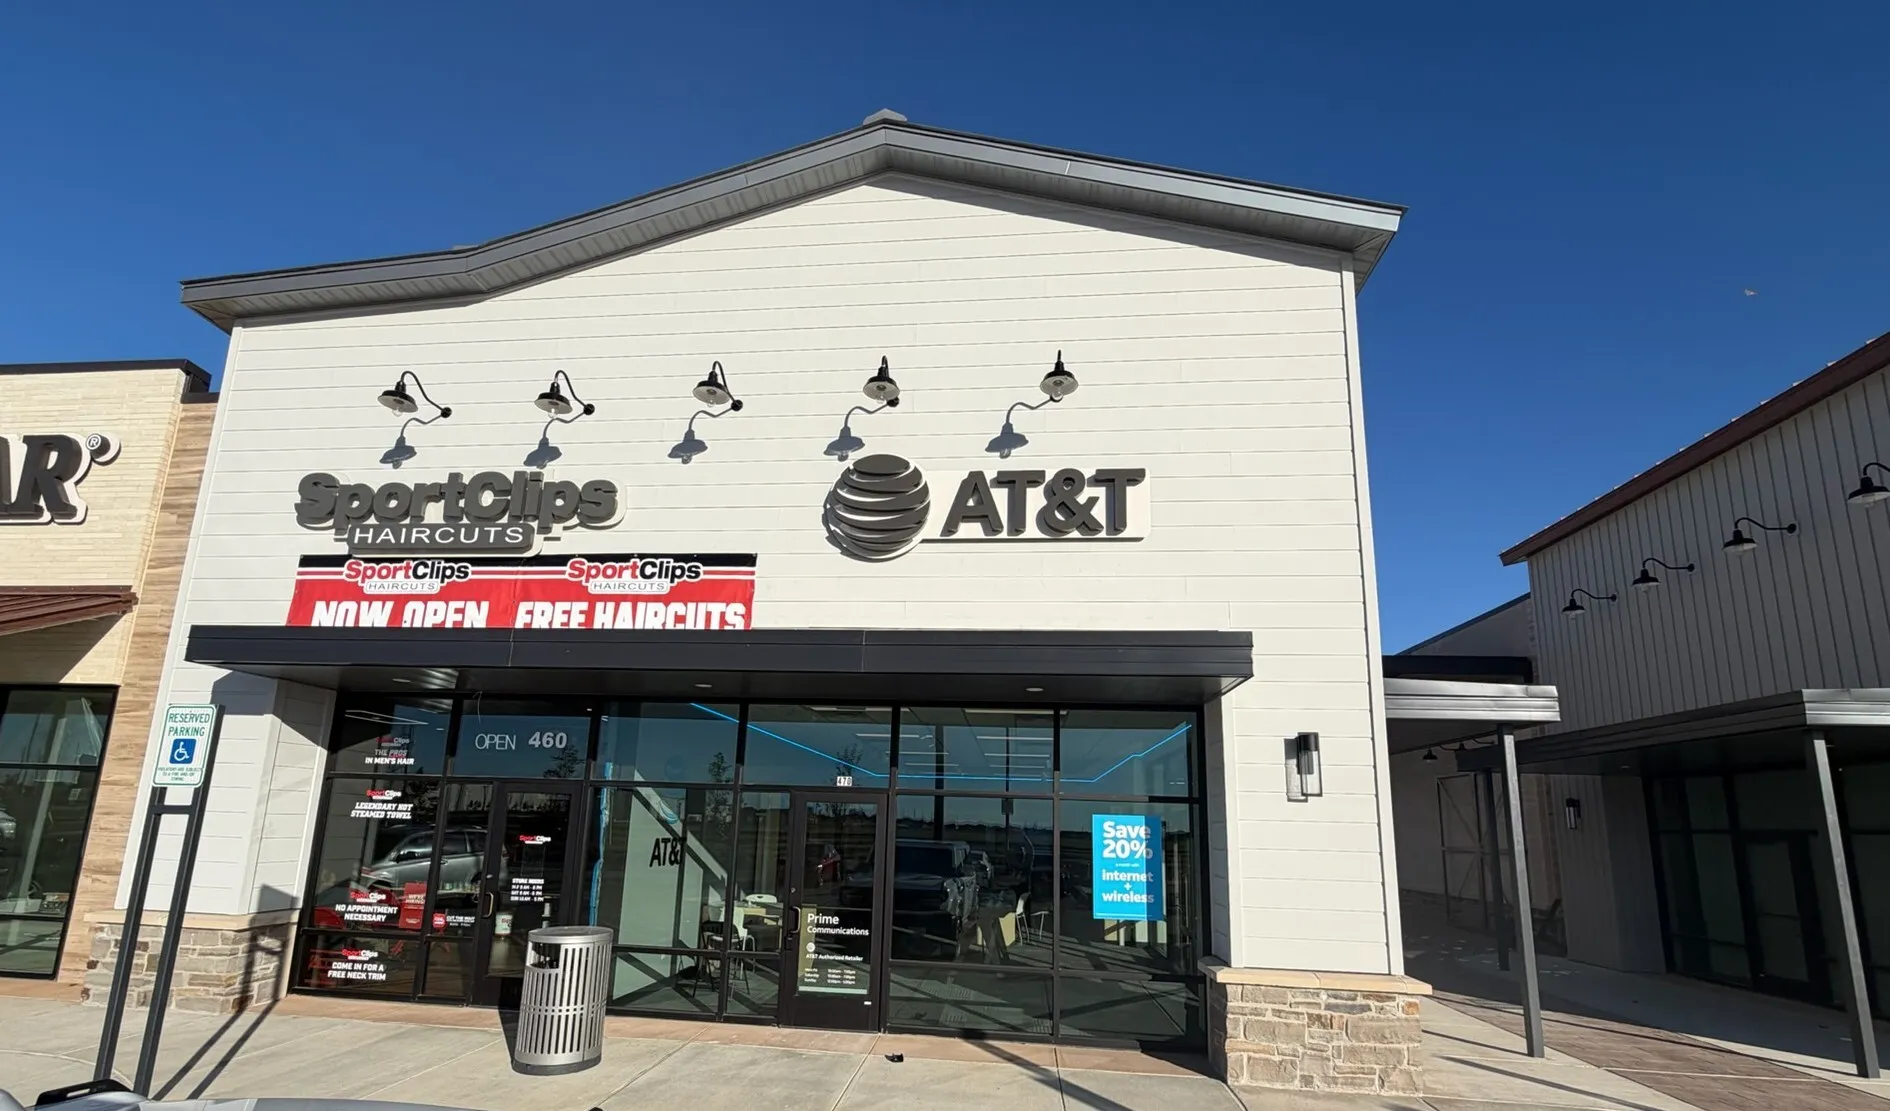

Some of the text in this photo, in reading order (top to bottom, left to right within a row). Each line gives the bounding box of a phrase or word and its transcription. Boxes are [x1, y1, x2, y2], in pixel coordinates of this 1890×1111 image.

[294, 470, 620, 534] SportClips
[940, 467, 1146, 537] AT&T
[353, 526, 524, 544] HAIRCUTS
[345, 560, 470, 583] SportClips
[568, 560, 701, 583] SportClips
[368, 581, 436, 590] HAIRCUTS
[593, 581, 665, 591] HAIRCUTS
[312, 600, 490, 628] NOW OPEN
[515, 601, 746, 629] FREE HAIRCUTS
[168, 713, 211, 723] RESERVED
[168, 726, 206, 737] PARKING
[475, 733, 517, 750] OPEN
[528, 731, 568, 749] 460
[374, 757, 396, 765] MEN'S
[355, 802, 397, 810] LEGENDARY
[350, 810, 412, 819] STEAMED TOWEL
[1103, 820, 1151, 839] Save
[1103, 839, 1154, 859] 20%
[1102, 869, 1154, 882] internet
[1102, 890, 1155, 903] wireless
[346, 905, 399, 914] APPOINTMENT
[344, 913, 387, 922] NECESSARY
[807, 913, 839, 924] Prime
[806, 925, 869, 936] Communications
[332, 962, 353, 970] COME
[378, 964, 385, 972] A
[327, 970, 387, 980] FREE NECK TRIM
